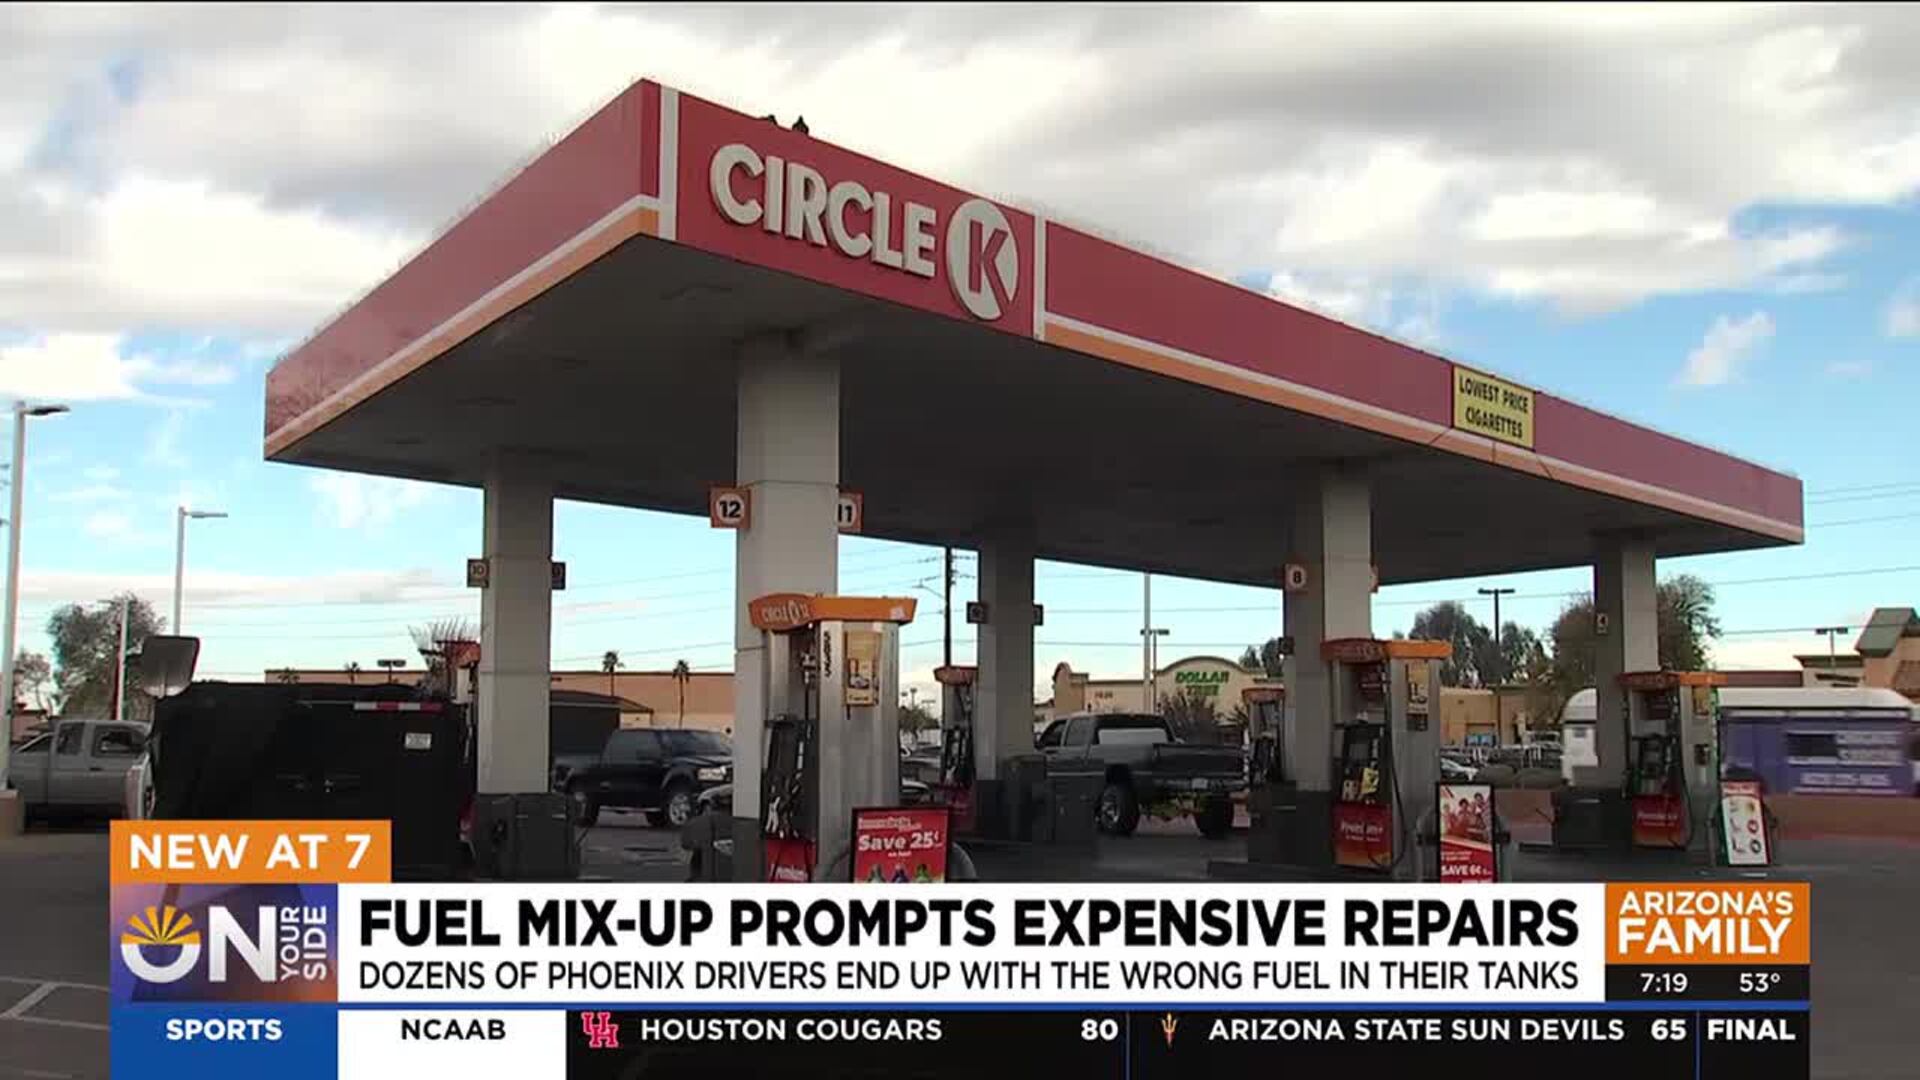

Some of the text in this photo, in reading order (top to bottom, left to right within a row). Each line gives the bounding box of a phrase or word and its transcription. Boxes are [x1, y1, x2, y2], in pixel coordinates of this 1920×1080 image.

[709, 143, 1015, 320] CIRCLE K
[1459, 374, 1529, 414] LOWEST PRICE
[1465, 406, 1523, 438] CIGARETTES
[719, 499, 741, 519] 12
[1293, 570, 1302, 585] 8
[1175, 671, 1230, 684] DOLLAR
[858, 834, 907, 851] Save
[1441, 864, 1469, 876] SAVE
